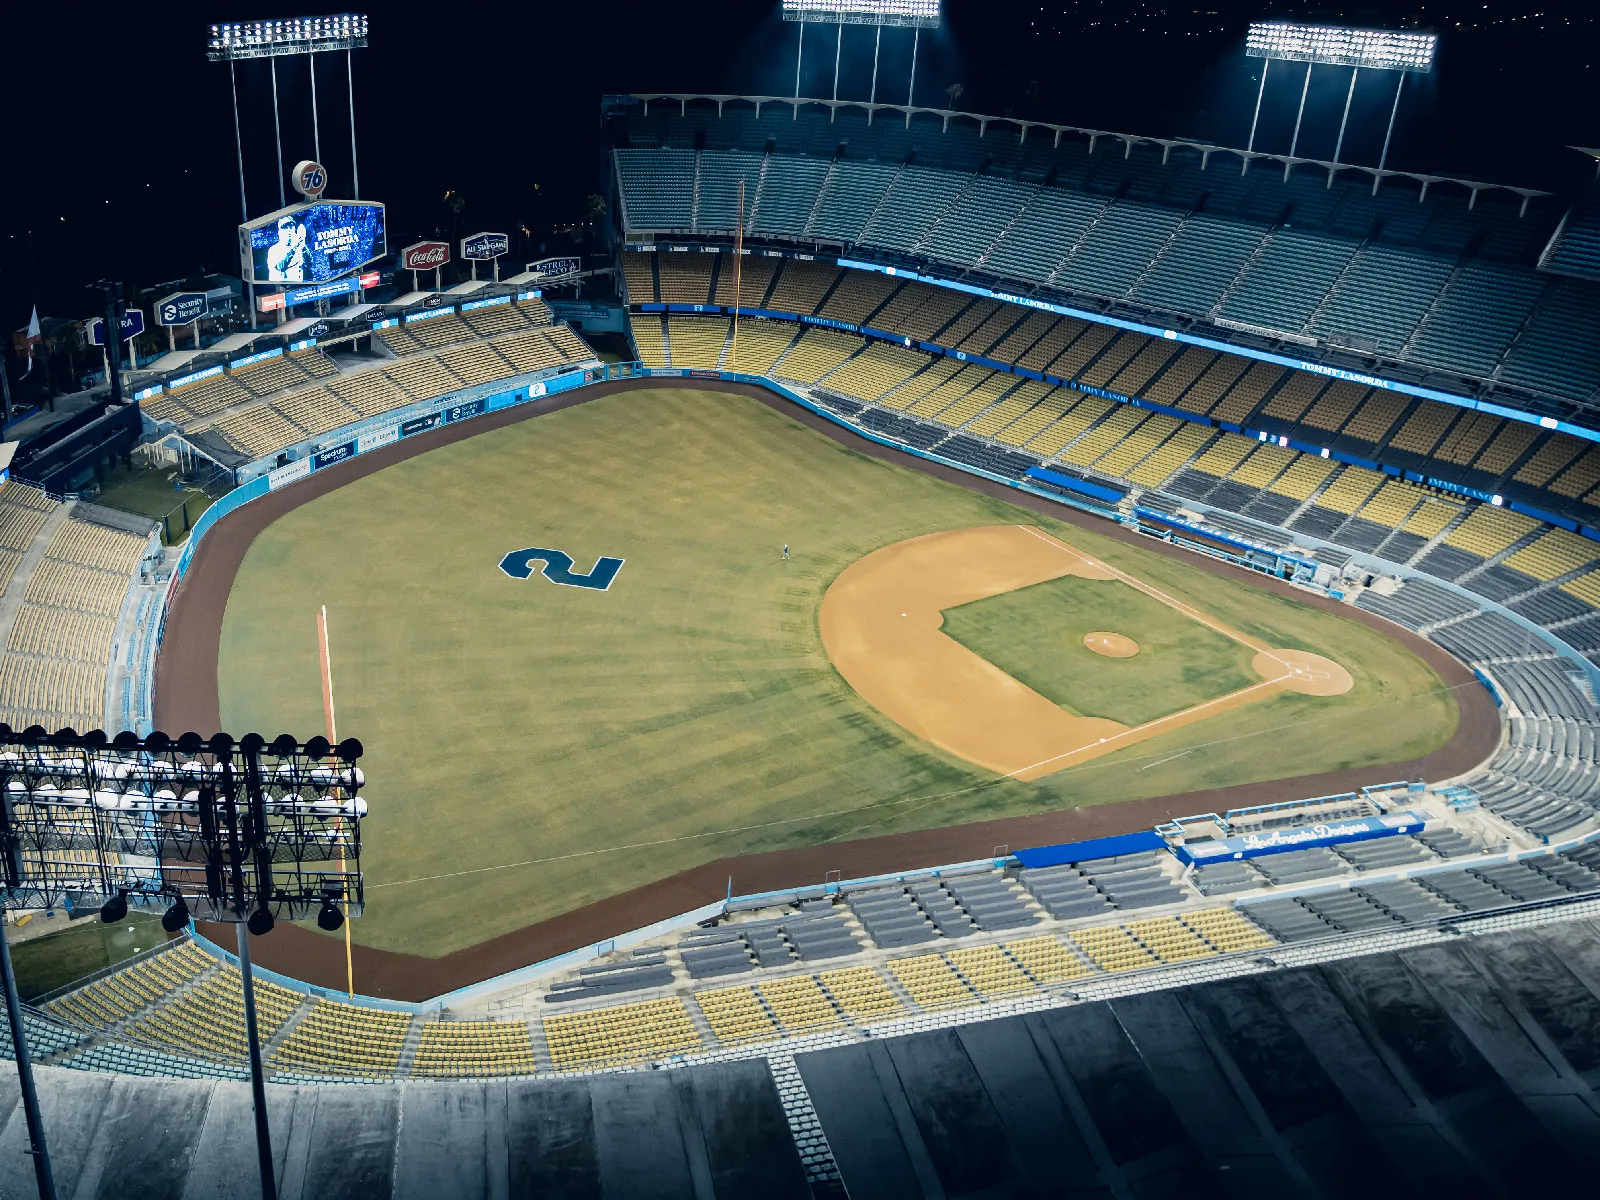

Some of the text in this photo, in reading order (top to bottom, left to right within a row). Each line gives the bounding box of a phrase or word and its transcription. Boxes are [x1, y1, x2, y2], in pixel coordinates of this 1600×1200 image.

[304, 168, 323, 190] 76
[316, 226, 354, 241] TOMMY
[314, 234, 359, 250] LASORDA
[177, 298, 204, 310] Security
[179, 306, 201, 318] Benefit
[1301, 362, 1389, 388] TOMMY LASORDA
[497, 547, 626, 592] 2
[1314, 823, 1370, 838] Dodgers
